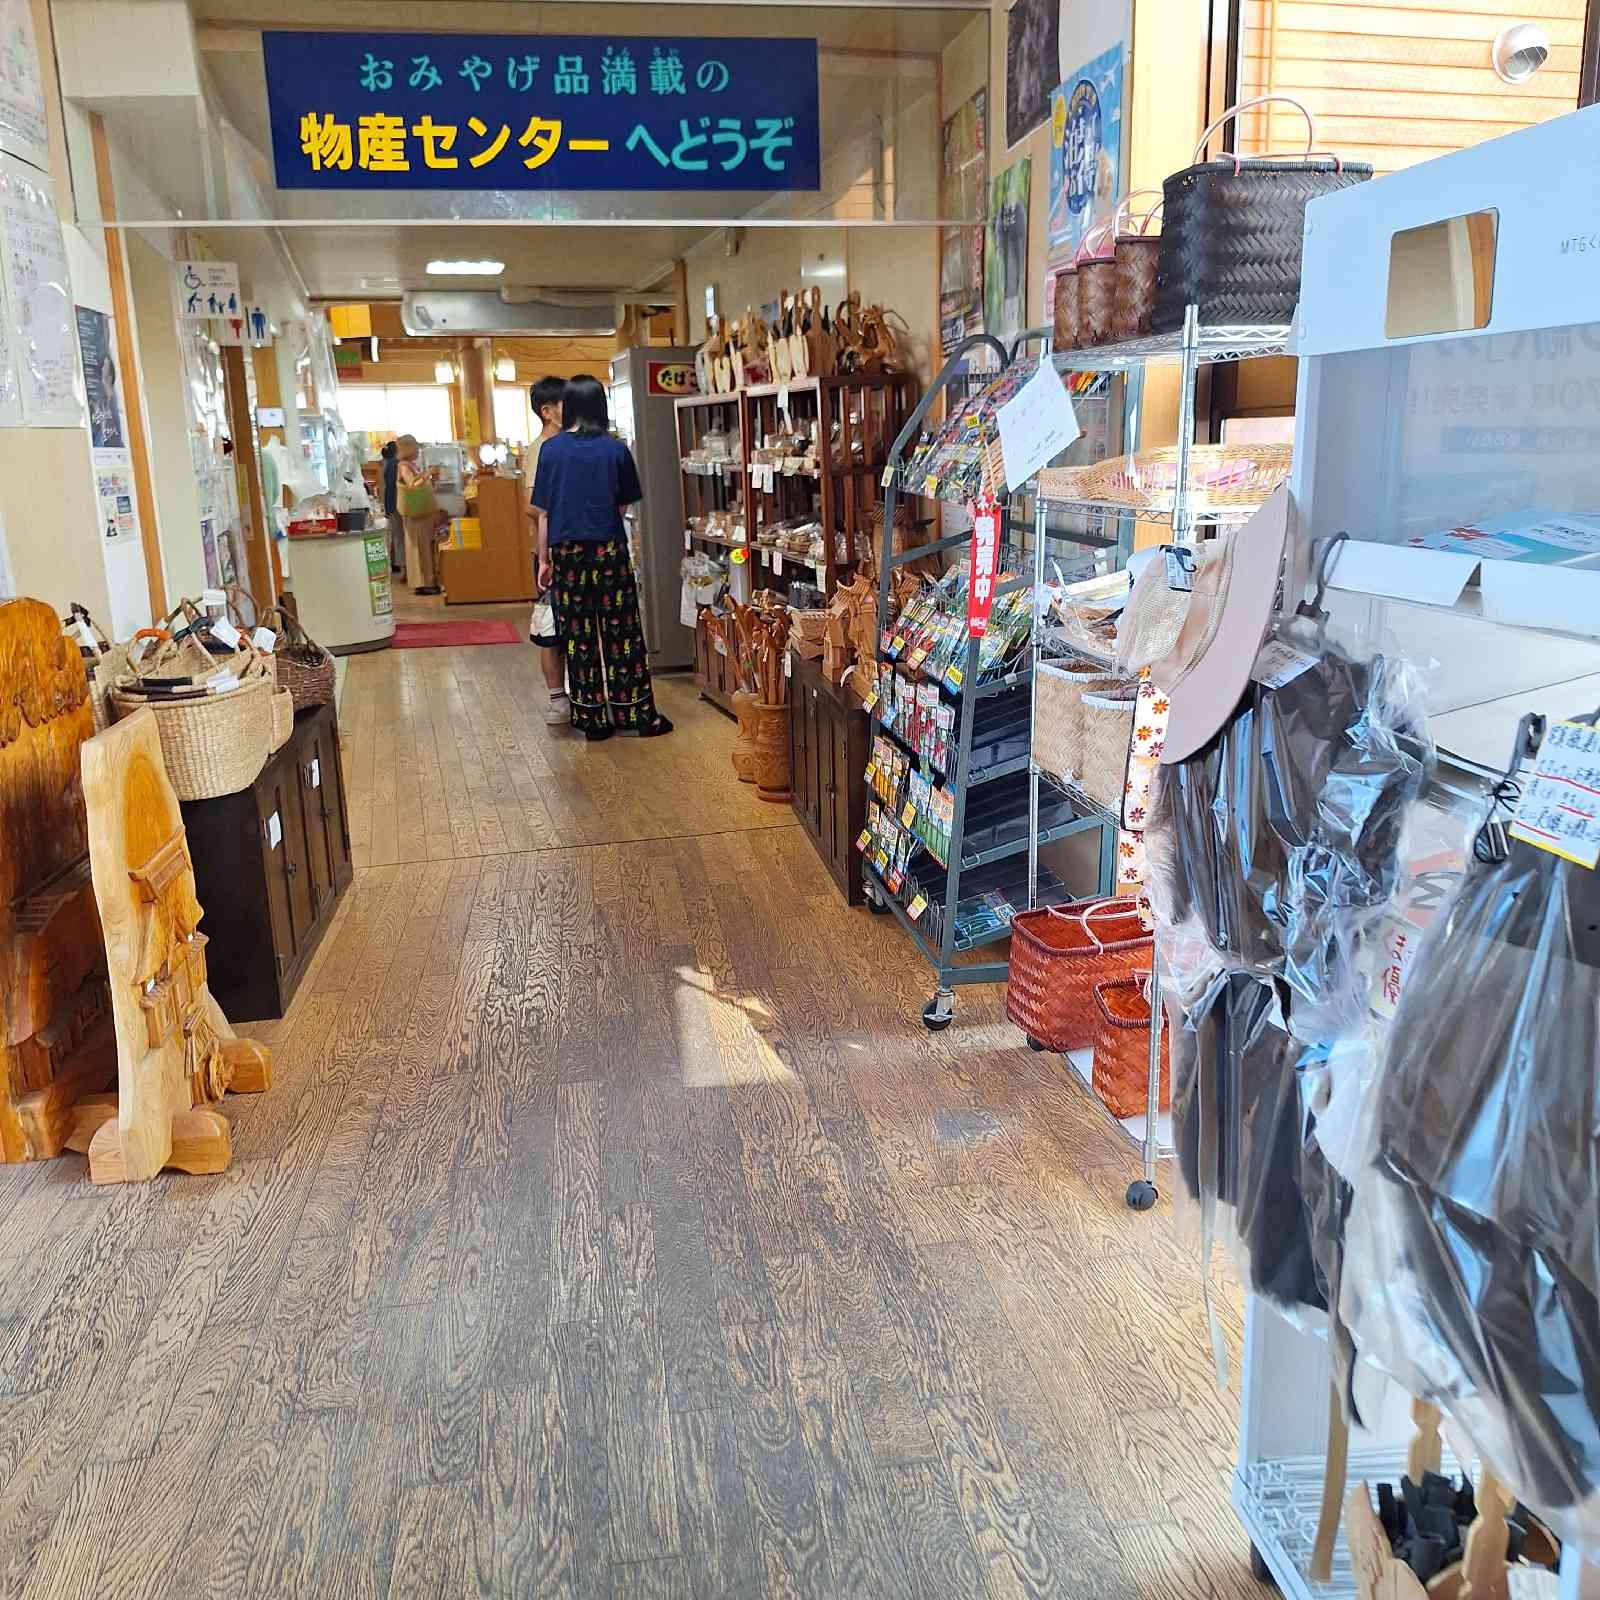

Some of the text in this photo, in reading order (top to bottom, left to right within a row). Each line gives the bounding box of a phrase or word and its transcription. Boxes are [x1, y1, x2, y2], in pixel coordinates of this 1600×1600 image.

[360, 53, 729, 96] おみやげ品満載の
